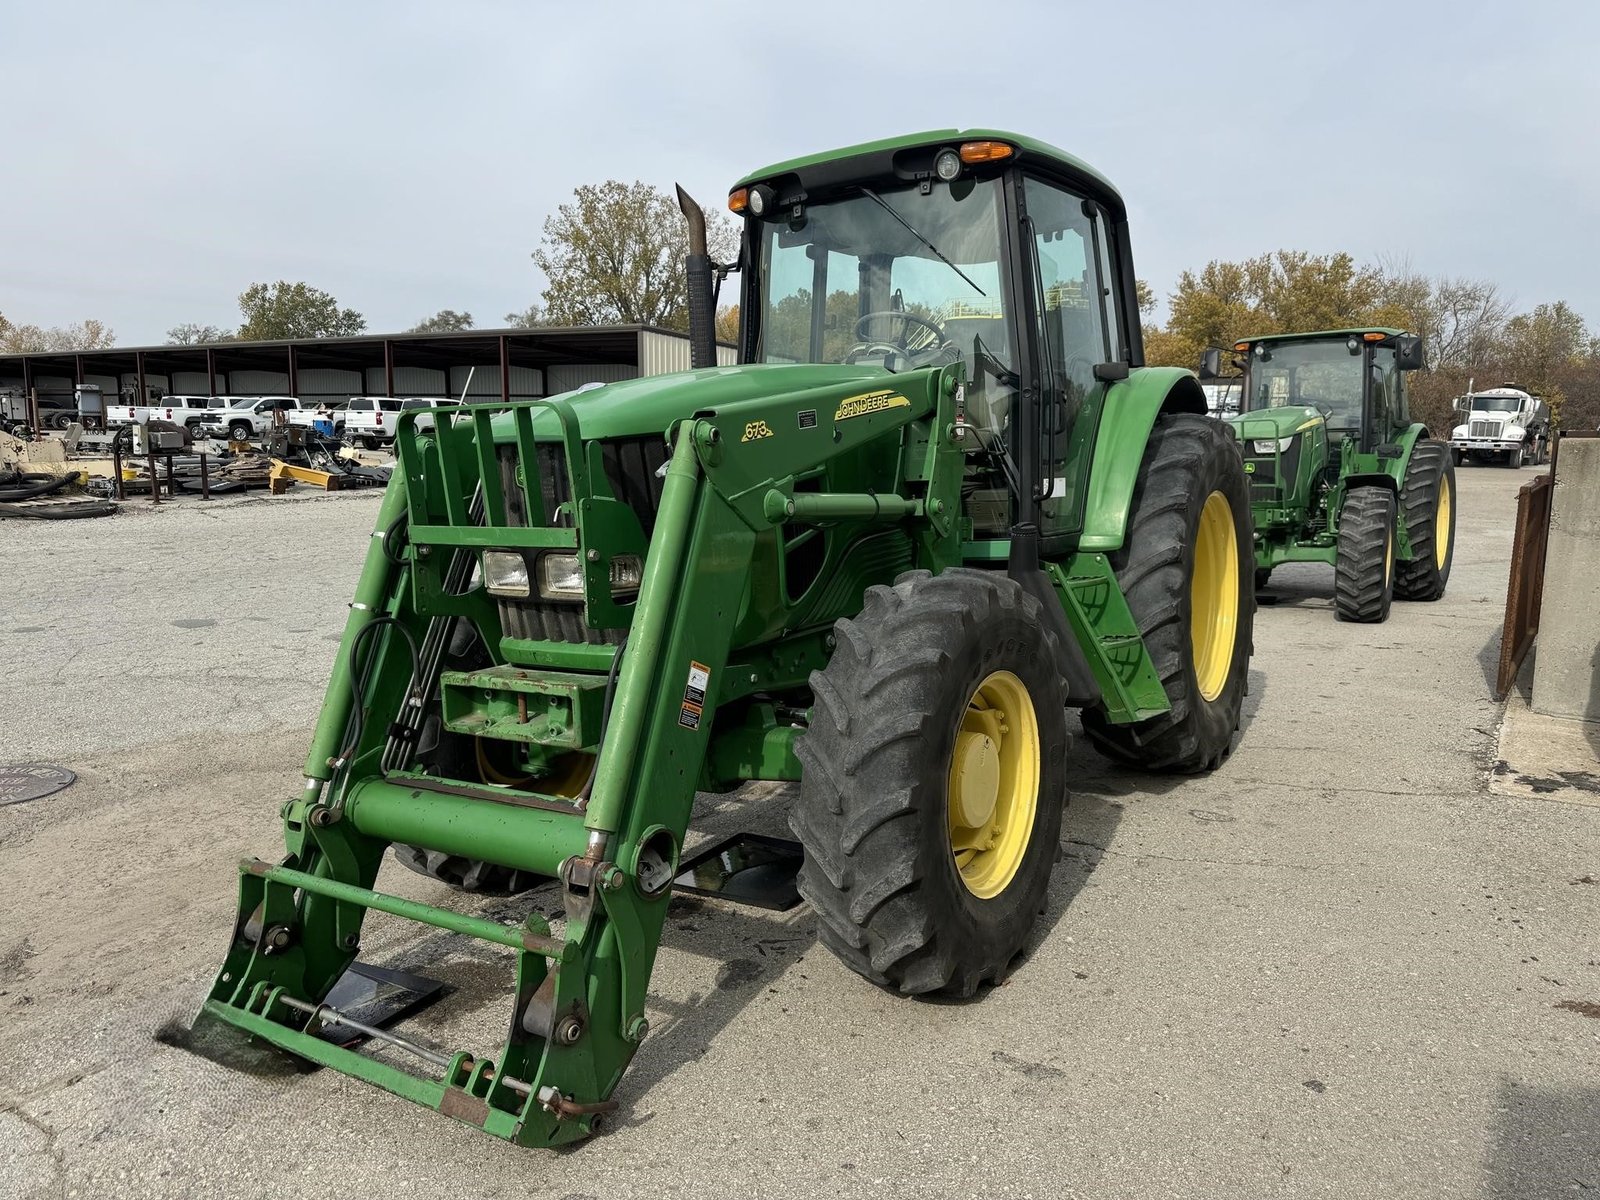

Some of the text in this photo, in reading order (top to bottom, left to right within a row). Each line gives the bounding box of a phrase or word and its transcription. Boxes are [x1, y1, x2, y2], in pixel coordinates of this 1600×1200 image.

[838, 395, 889, 418] JOHN DEERE
[745, 420, 767, 439] 673
